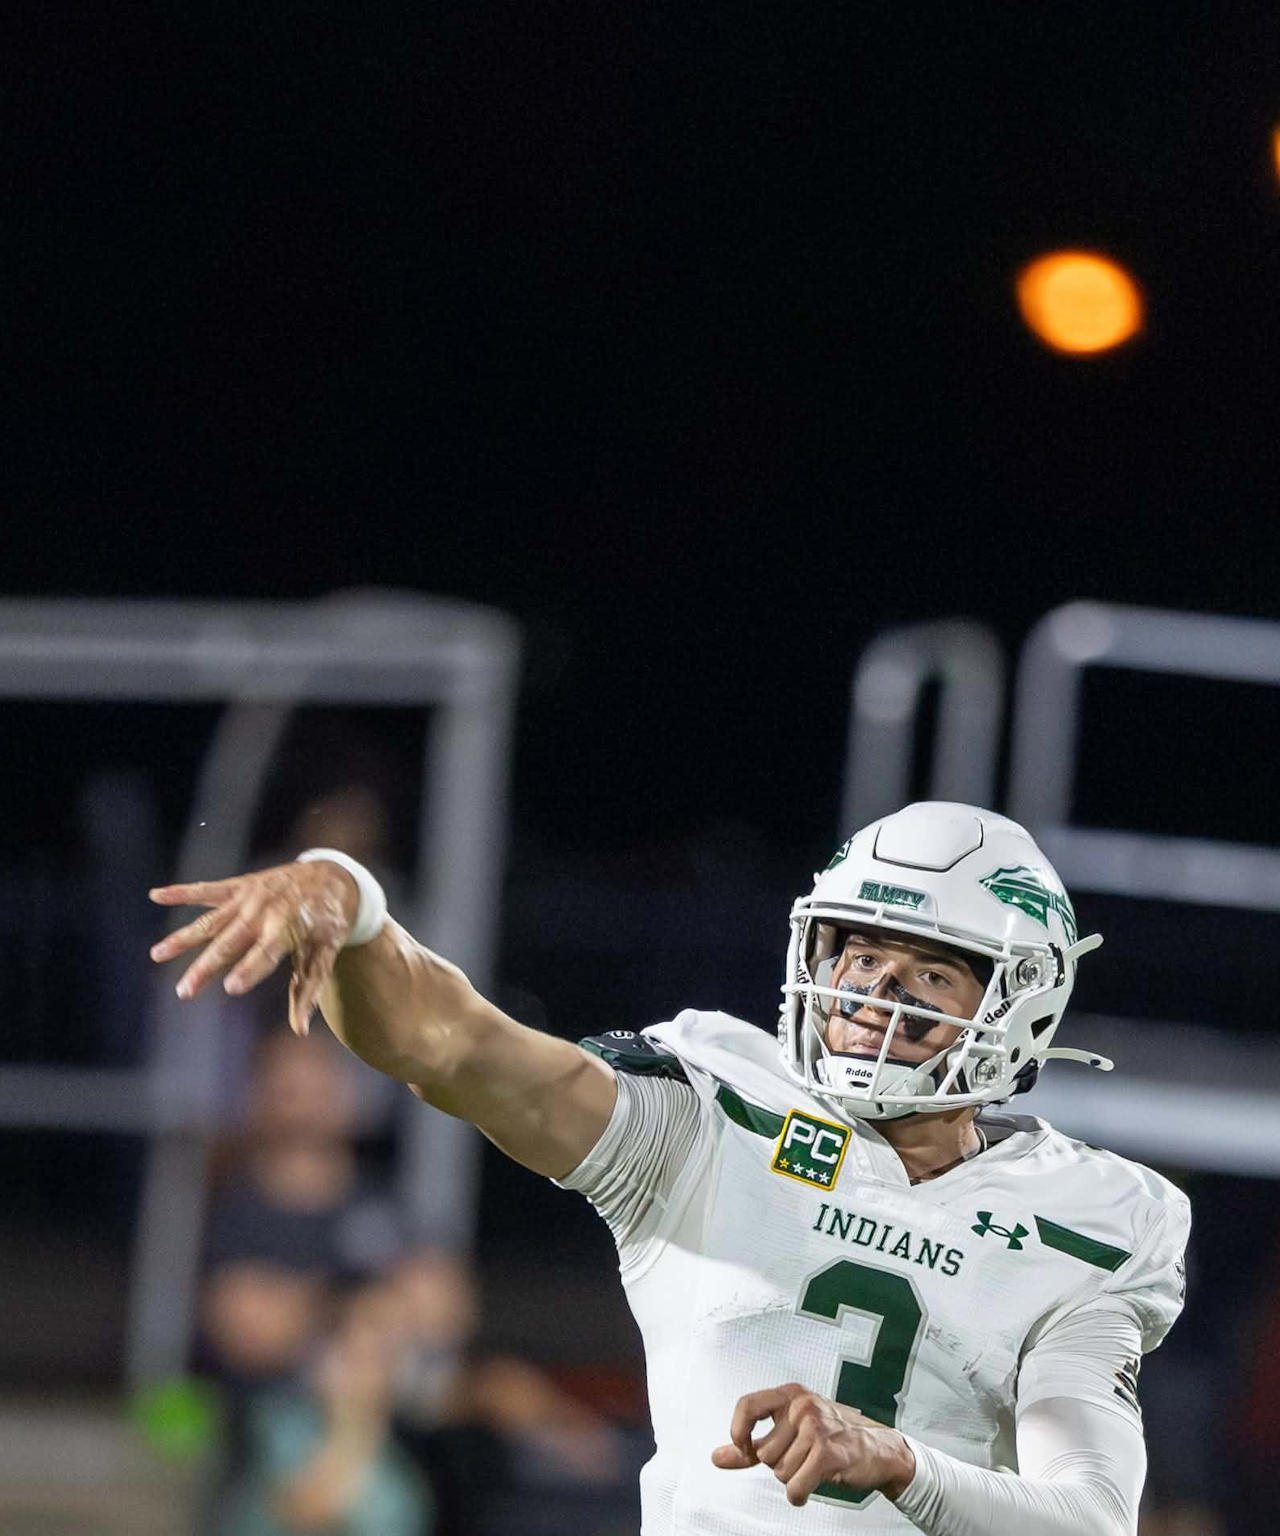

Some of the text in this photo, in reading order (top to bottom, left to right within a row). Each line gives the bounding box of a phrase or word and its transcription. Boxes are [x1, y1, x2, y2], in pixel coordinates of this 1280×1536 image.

[783, 1118, 844, 1165] PC
[813, 1203, 965, 1277] INDIANS
[795, 1256, 929, 1510] 3
